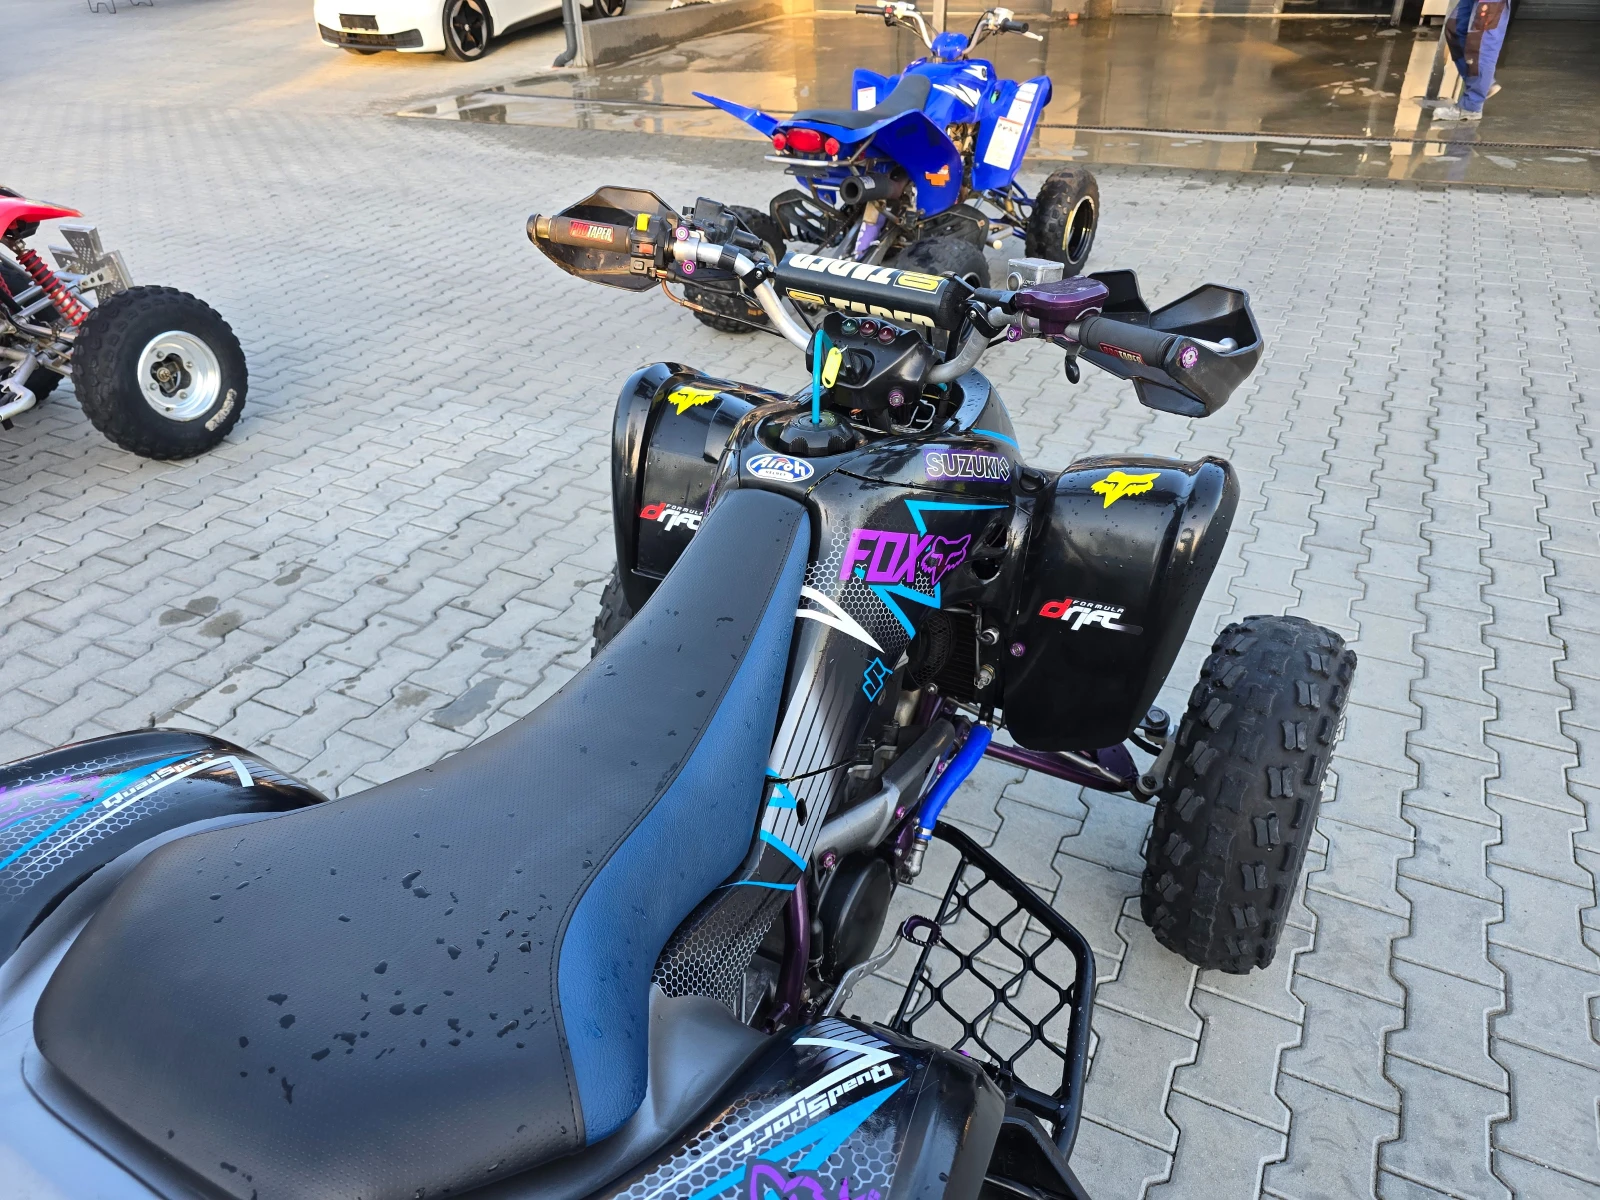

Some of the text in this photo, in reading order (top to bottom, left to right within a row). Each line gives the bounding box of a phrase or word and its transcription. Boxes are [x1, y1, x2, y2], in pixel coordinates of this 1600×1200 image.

[750, 456, 806, 477] Airoh
[926, 452, 1001, 480] SUZUKI
[839, 528, 933, 585] FOX
[1039, 598, 1128, 631] drift
[1072, 600, 1125, 614] FORMULA
[101, 752, 217, 809] QuadSport
[735, 1062, 893, 1158] QuadSport
